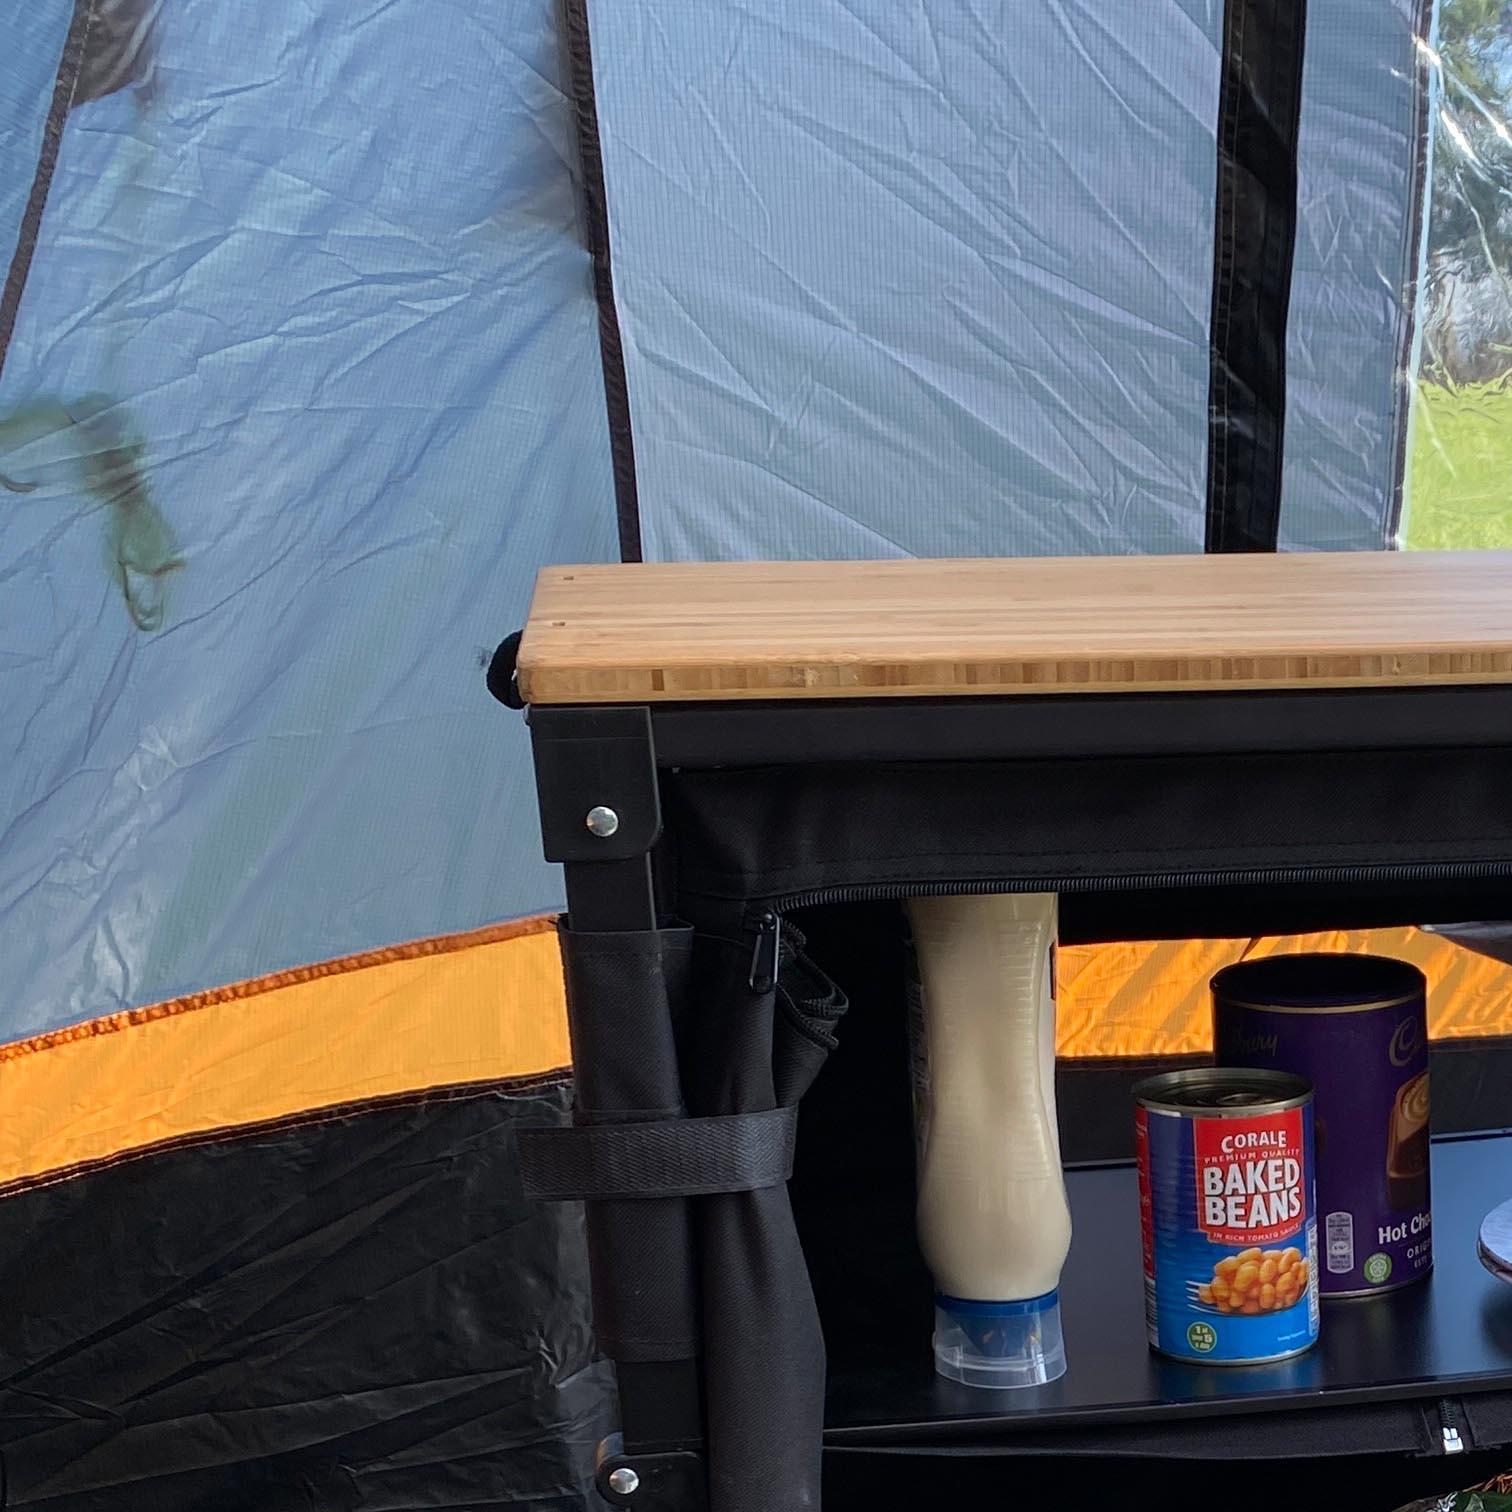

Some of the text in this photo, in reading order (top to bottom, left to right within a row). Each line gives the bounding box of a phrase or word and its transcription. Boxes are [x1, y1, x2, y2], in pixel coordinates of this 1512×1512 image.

[1221, 1130, 1287, 1154] CORALE
[1204, 1151, 1256, 1164] PREMIUM
[1203, 1158, 1301, 1196] BAKED
[1205, 1186, 1301, 1228] BEANS
[1378, 1222, 1407, 1245] Hot
